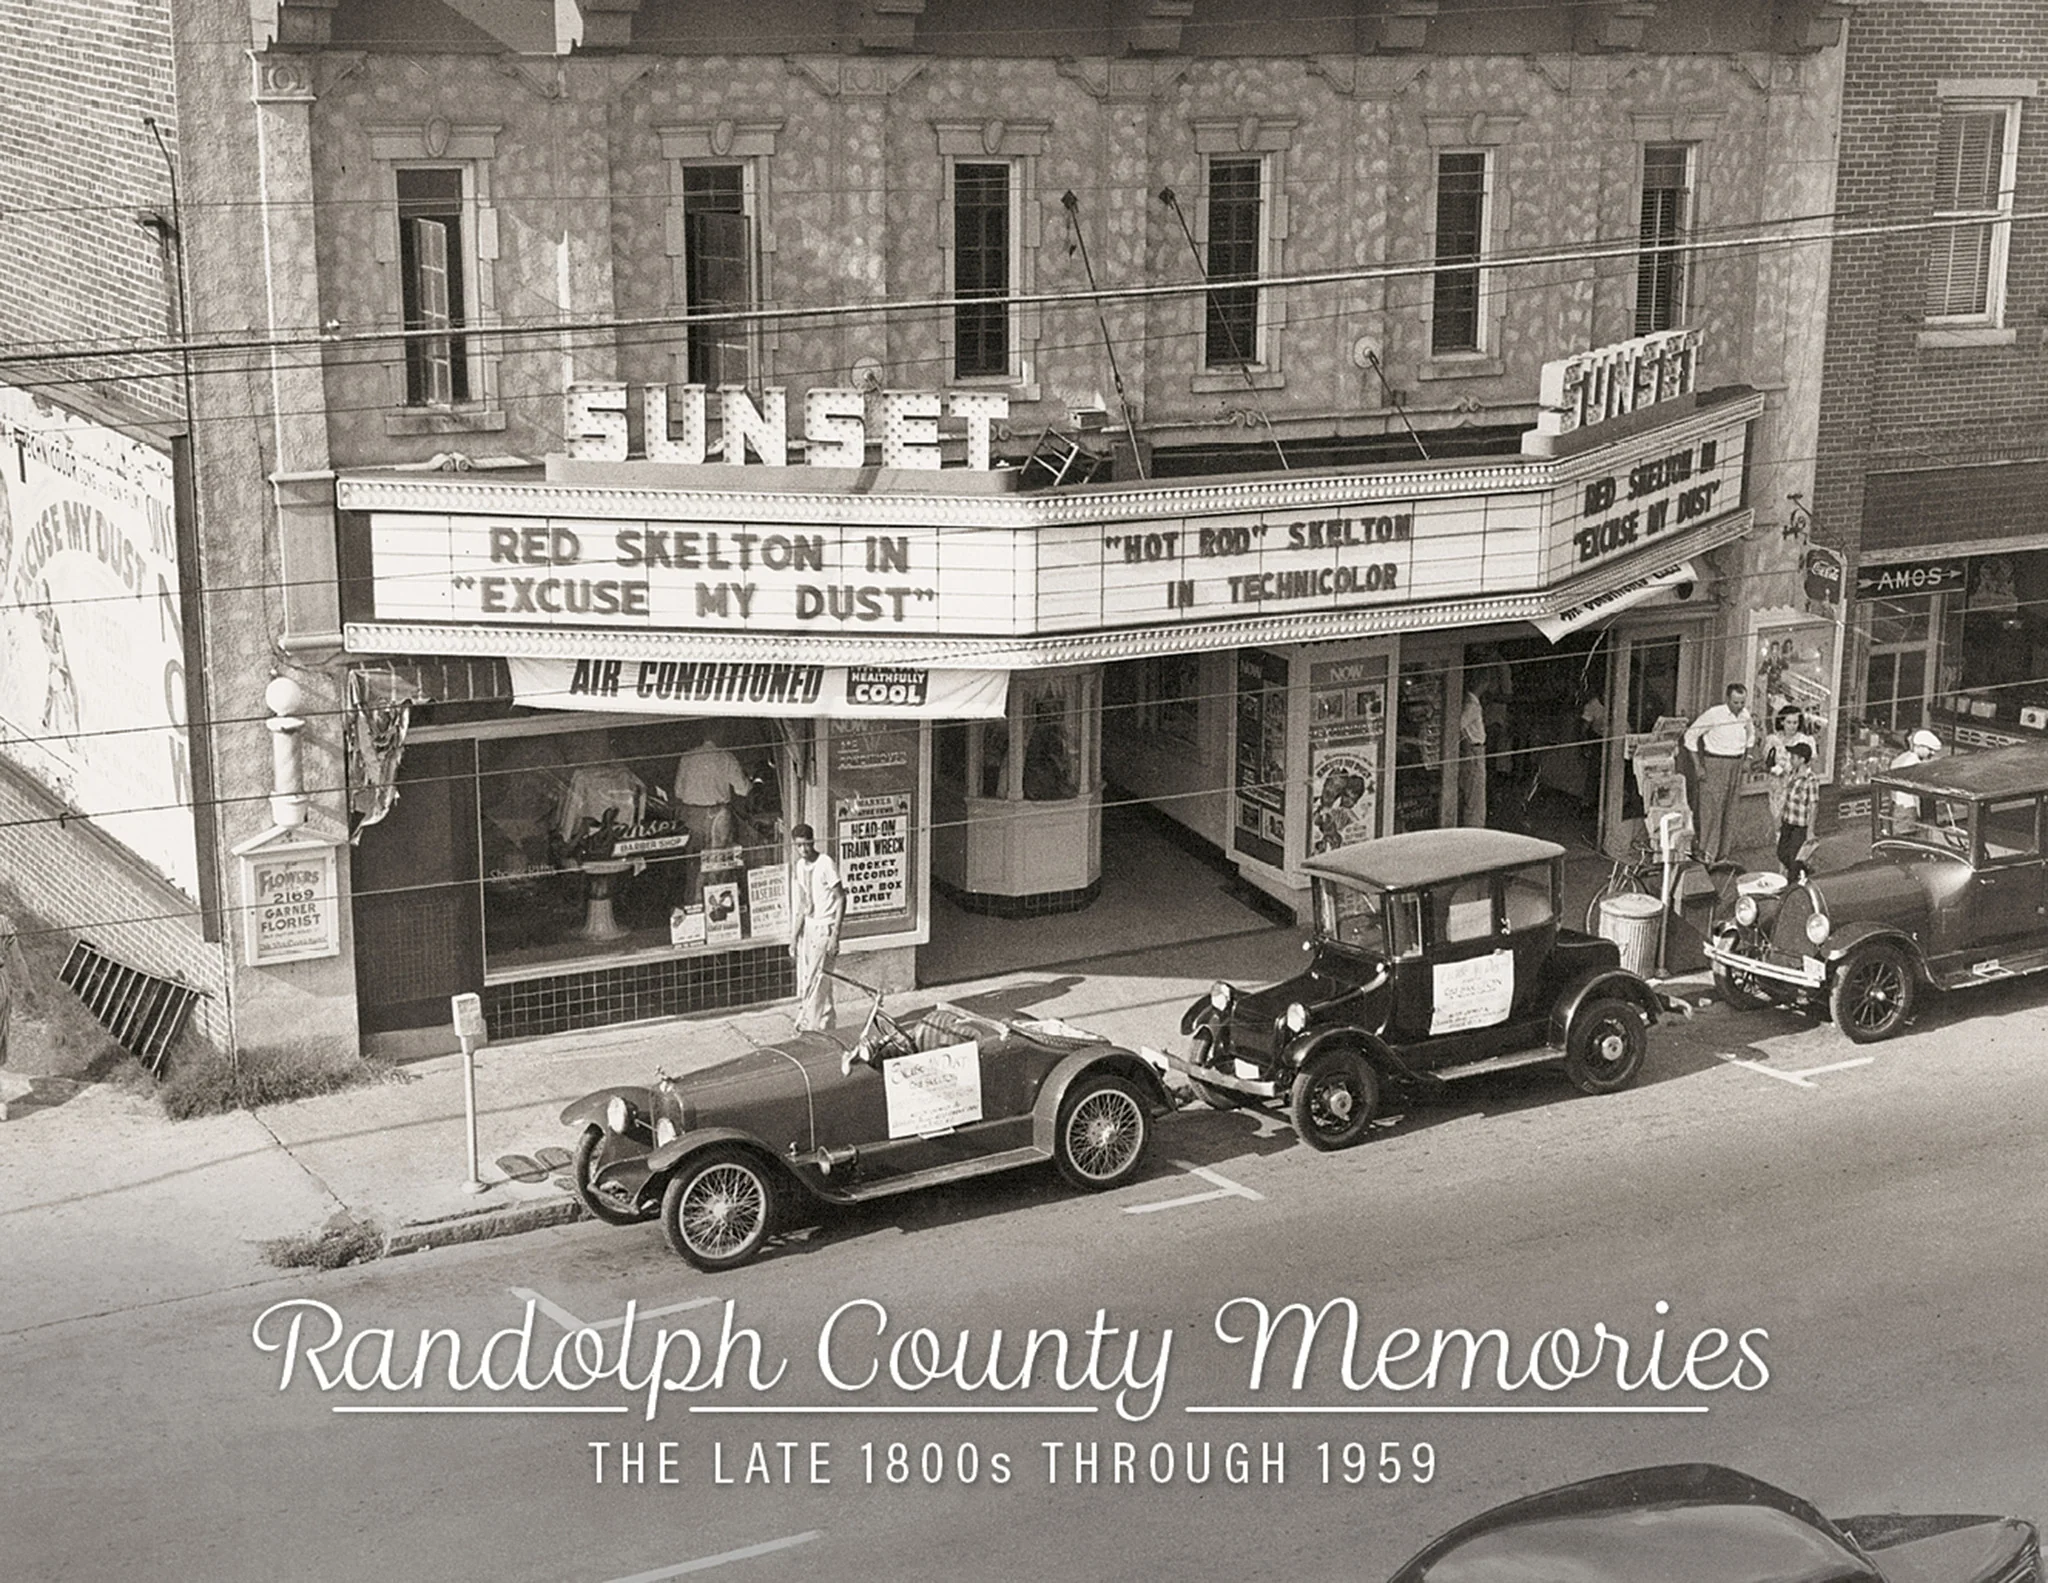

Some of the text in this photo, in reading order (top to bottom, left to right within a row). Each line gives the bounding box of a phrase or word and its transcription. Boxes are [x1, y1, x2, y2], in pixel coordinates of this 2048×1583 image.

[1540, 329, 1704, 437] SUNSET
[566, 382, 1009, 470] SUNSET
[1584, 477, 1617, 518] RED
[1627, 448, 1694, 500] SKELTON
[1647, 498, 1669, 535] MY
[63, 500, 92, 553] MY
[95, 509, 147, 602] DUST
[489, 526, 908, 573] RED SKELTON IN
[1105, 514, 1411, 564] "HOT ROD" SKELTON
[1167, 563, 1399, 609] IN TECHNICOLOR
[1877, 567, 1942, 591] AMOS
[451, 575, 935, 622] "EXCUSE MY DUST"
[569, 658, 825, 704] AIR CONDITIONED
[851, 671, 926, 684] HEALTHFULLY
[1330, 665, 1365, 682] NOW
[855, 684, 921, 703] COOL
[851, 820, 897, 839] HEAD-ON
[659, 838, 682, 849] SHOP
[841, 837, 905, 859] TRAIN WRECK
[849, 859, 897, 871] ROCKET
[258, 870, 320, 897] FLOWERS
[879, 880, 902, 892] BOX
[853, 892, 892, 904] DERBY
[264, 902, 316, 919] GARNER
[261, 914, 321, 933] FLORIST
